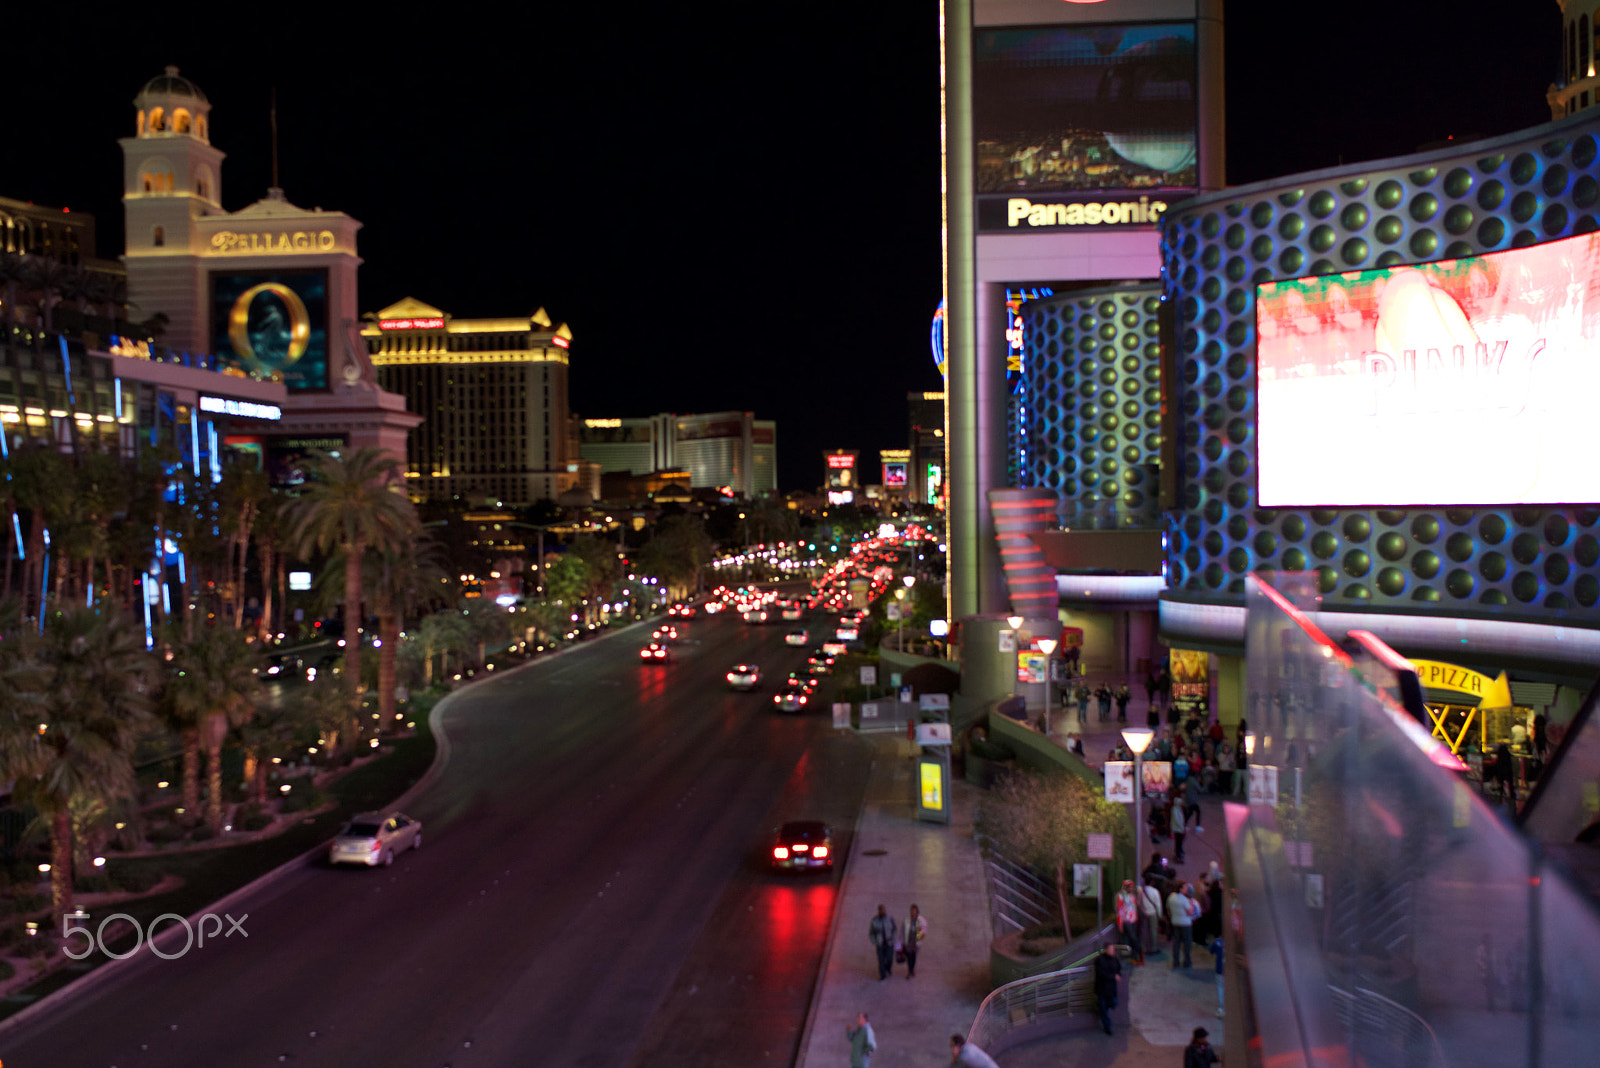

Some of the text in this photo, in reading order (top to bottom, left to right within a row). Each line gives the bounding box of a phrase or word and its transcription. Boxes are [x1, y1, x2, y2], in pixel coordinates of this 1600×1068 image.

[1008, 196, 1167, 227] Panasonic
[211, 230, 335, 252] BELLAGIO
[1431, 665, 1481, 693] PIZZA
